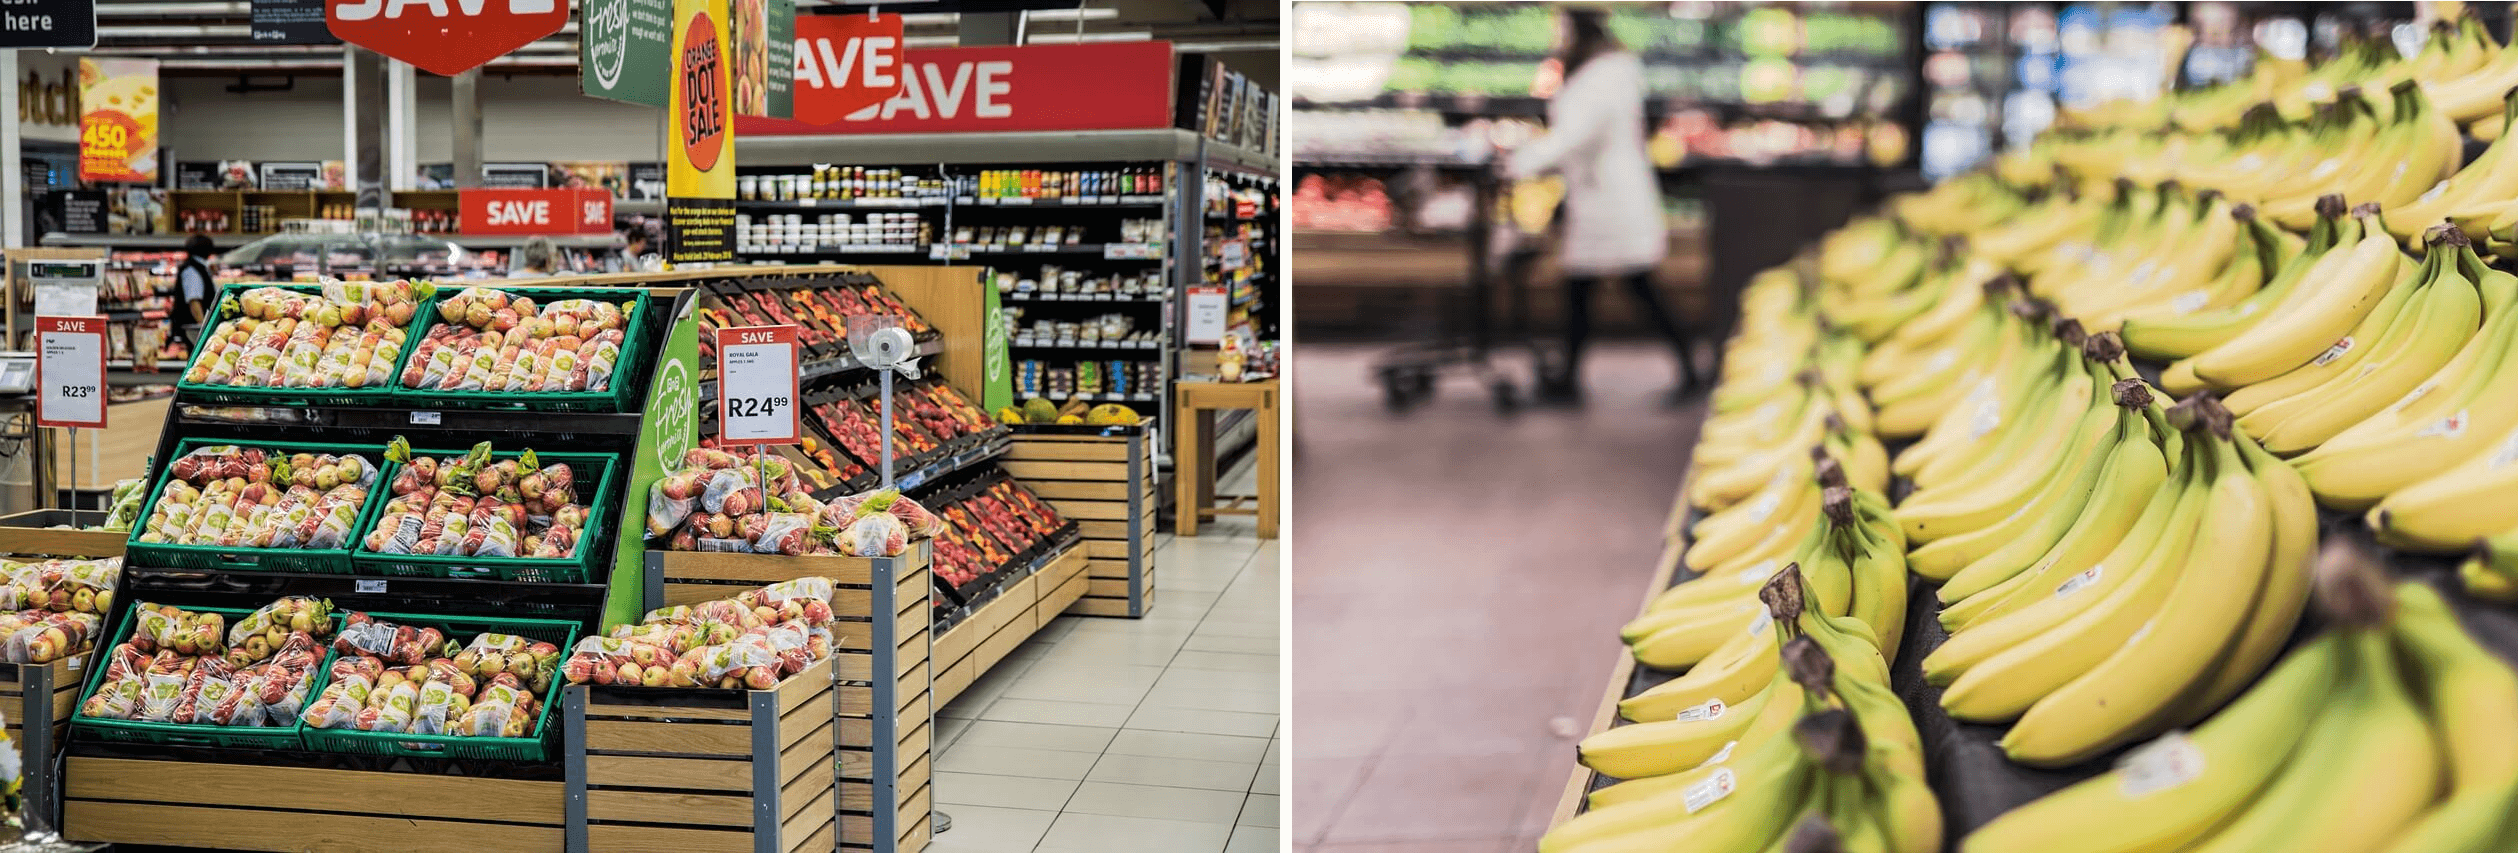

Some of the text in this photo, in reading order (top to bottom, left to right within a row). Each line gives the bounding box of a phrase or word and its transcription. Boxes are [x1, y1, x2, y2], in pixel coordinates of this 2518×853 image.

[5, 11, 53, 31] here
[686, 37, 716, 70] ORANGE
[794, 36, 896, 89] AVE
[687, 60, 716, 110] DOT
[844, 61, 1013, 121] AVE
[83, 124, 127, 148] 450
[688, 98, 721, 147] SALE
[486, 200, 550, 226] SAVE
[57, 320, 86, 332] SAVE
[741, 331, 774, 344] SAVE
